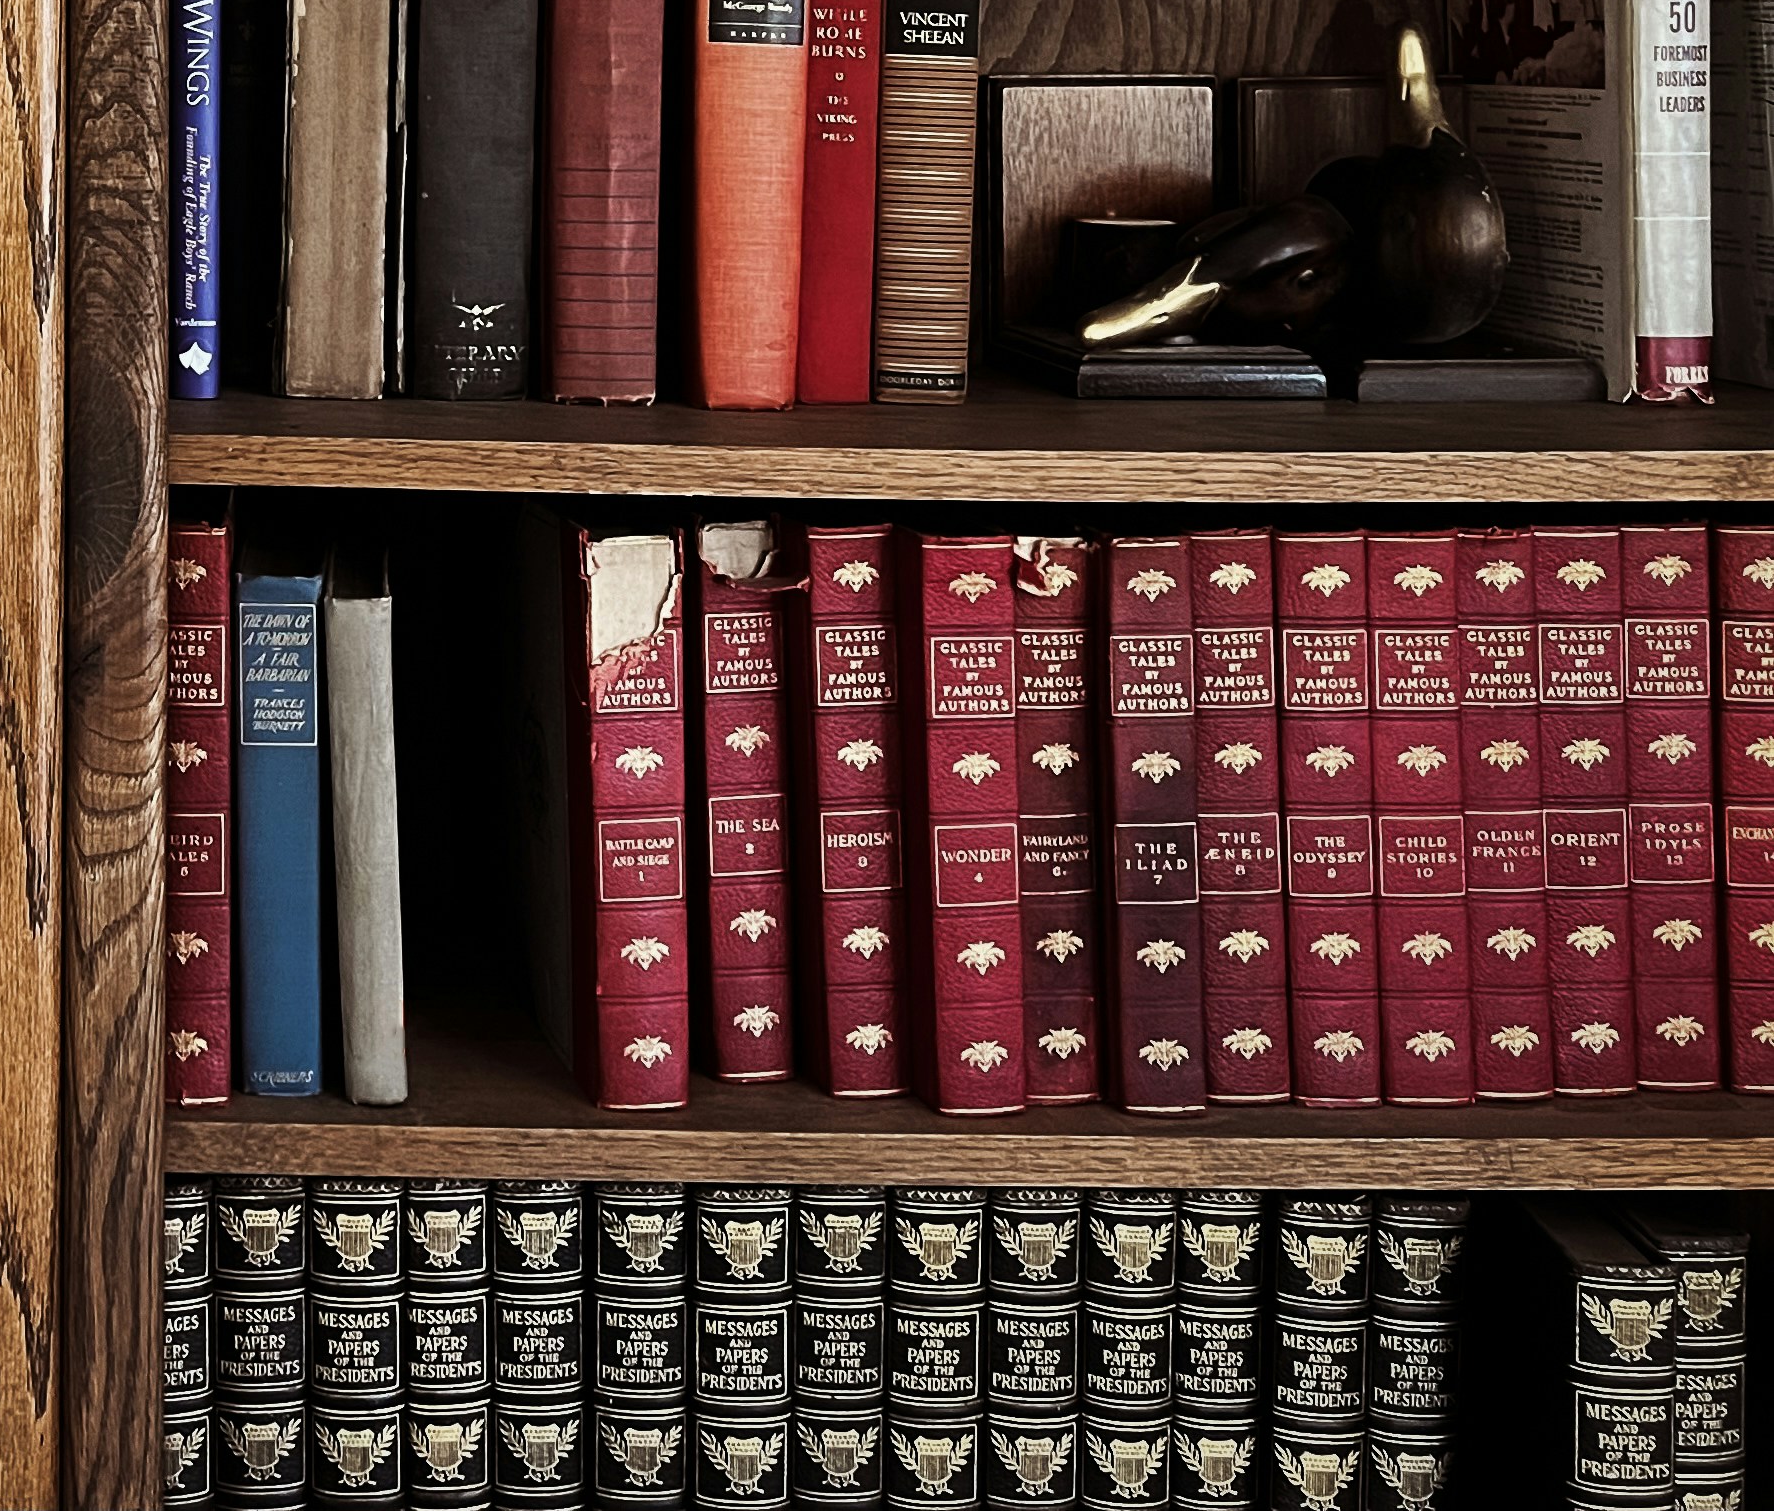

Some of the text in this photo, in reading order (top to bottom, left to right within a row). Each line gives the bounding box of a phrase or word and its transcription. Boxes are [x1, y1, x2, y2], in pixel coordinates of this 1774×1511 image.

[900, 12, 969, 27] VINCENT
[1669, 1, 1696, 33] 50
[903, 30, 964, 44] SHEEAN
[812, 45, 866, 58] BURNS
[1654, 45, 1707, 62] FOREMOST
[1657, 71, 1707, 87] BUSINESS
[1660, 96, 1705, 113] LEADERS
[817, 114, 857, 124] VIKING
[200, 155, 211, 178] The
[199, 181, 210, 210] True
[183, 200, 197, 235] Eagle
[194, 246, 210, 264] of
[199, 265, 210, 282] the
[185, 271, 197, 309] Ranch
[243, 614, 312, 628] THE DAWN OF
[243, 632, 254, 646] A
[1292, 635, 1357, 647] CLASSIC
[252, 652, 300, 667] A FAIR
[1303, 650, 1350, 662] TALES
[246, 668, 311, 682] BARBARIAN
[1296, 677, 1357, 689] FAMOUS
[254, 699, 305, 708] FRANCES
[1290, 692, 1363, 704] AUTHORS
[253, 710, 305, 719] HODGSON
[252, 720, 306, 734] BURNETT
[716, 819, 780, 834] THE SEA
[827, 831, 893, 848] HEROISM
[1395, 836, 1447, 848] CHILD
[1550, 832, 1621, 848] ORIENT
[1645, 839, 1702, 850] IDYLS
[942, 848, 1011, 863] WONDER
[1135, 843, 1177, 855] THE
[637, 855, 669, 866] SIEGE
[1294, 851, 1366, 863] ODYSSEY
[1387, 852, 1457, 864] STORIES
[1580, 856, 1597, 867] 12
[1126, 858, 1188, 871] ILIAD
[1154, 875, 1163, 884] 7
[897, 1319, 970, 1338] MESSAGES
[907, 1347, 960, 1365] PAPERS
[893, 1372, 973, 1391] PRESIDENTS
[1585, 1402, 1667, 1423] MESSAGES
[1614, 1424, 1638, 1434] AND
[1598, 1433, 1657, 1451] PAPERS
[1605, 1452, 1651, 1462] OF THE
[1582, 1458, 1670, 1480] PRESIDENTS
